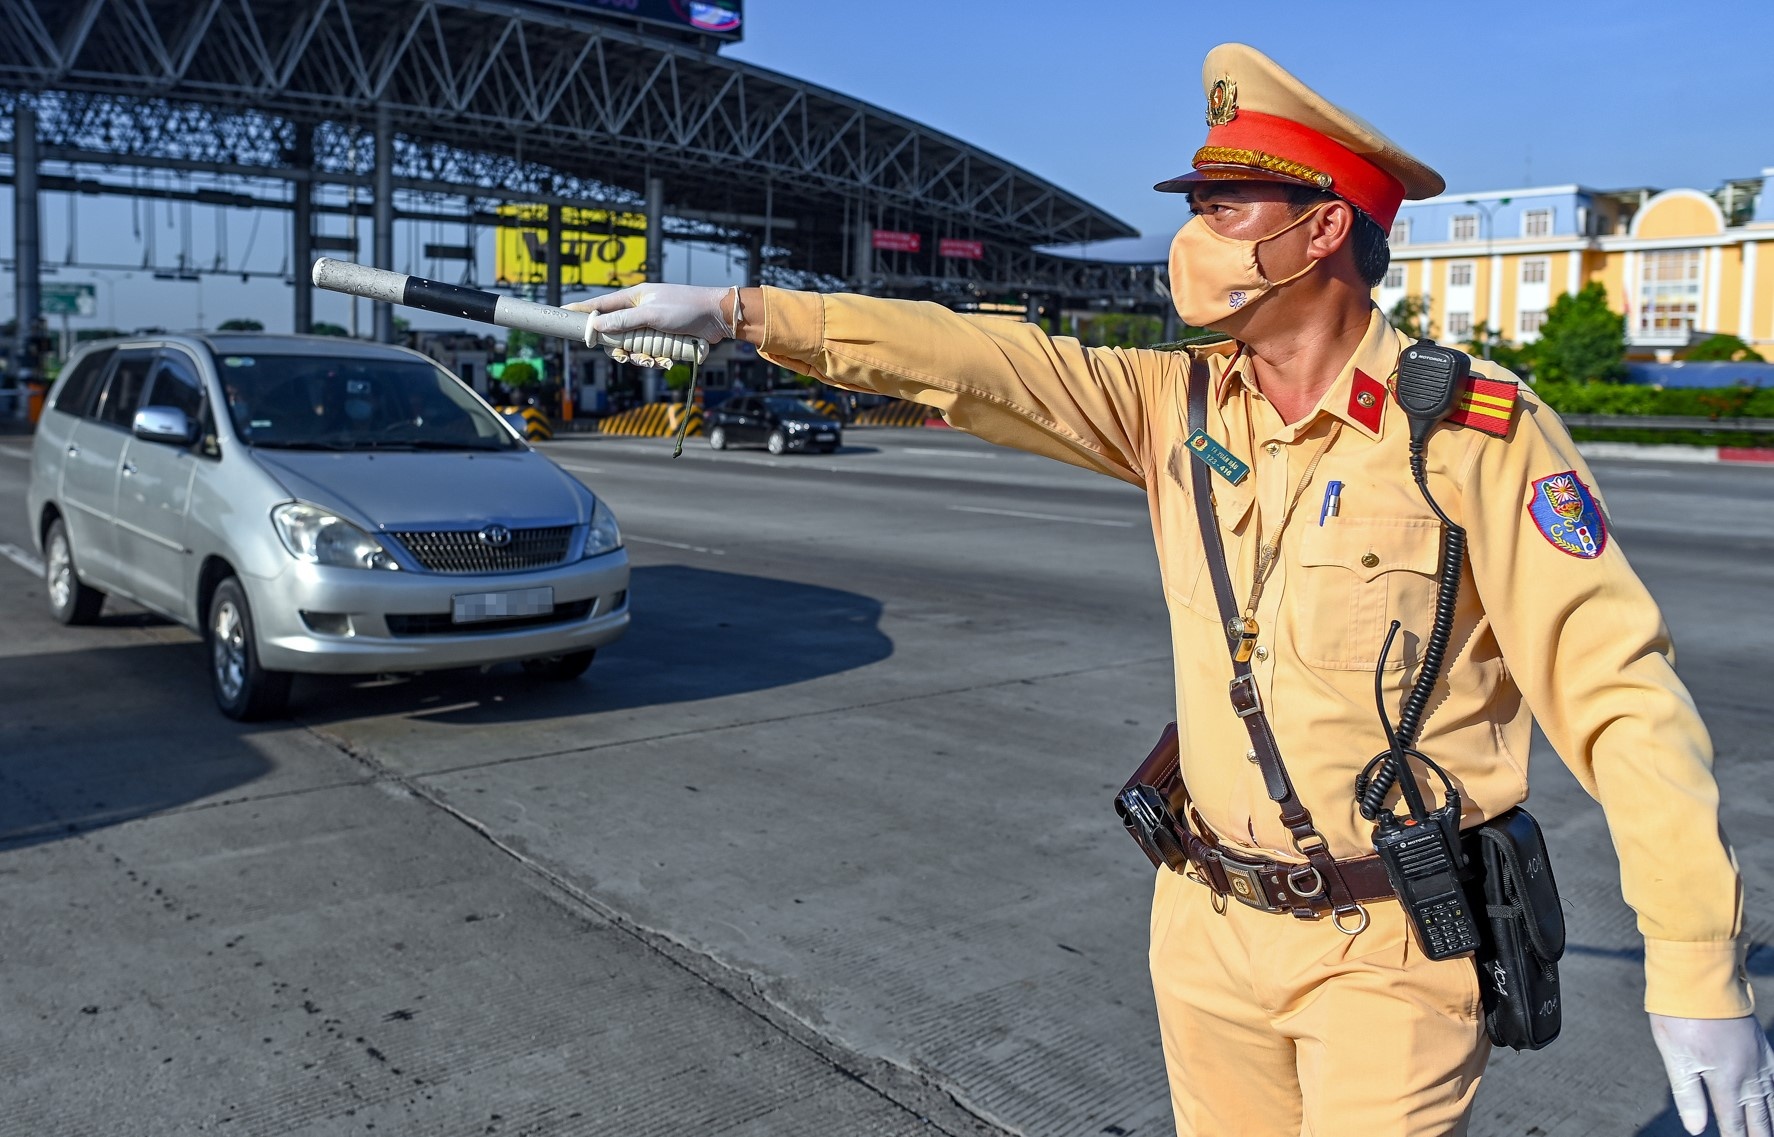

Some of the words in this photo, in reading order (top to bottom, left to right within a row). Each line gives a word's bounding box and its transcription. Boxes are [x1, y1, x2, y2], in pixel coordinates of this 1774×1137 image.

[522, 231, 626, 264] VTTO
[1418, 354, 1447, 363] MOTOROLA
[1407, 834, 1435, 846] MOTOROLA
